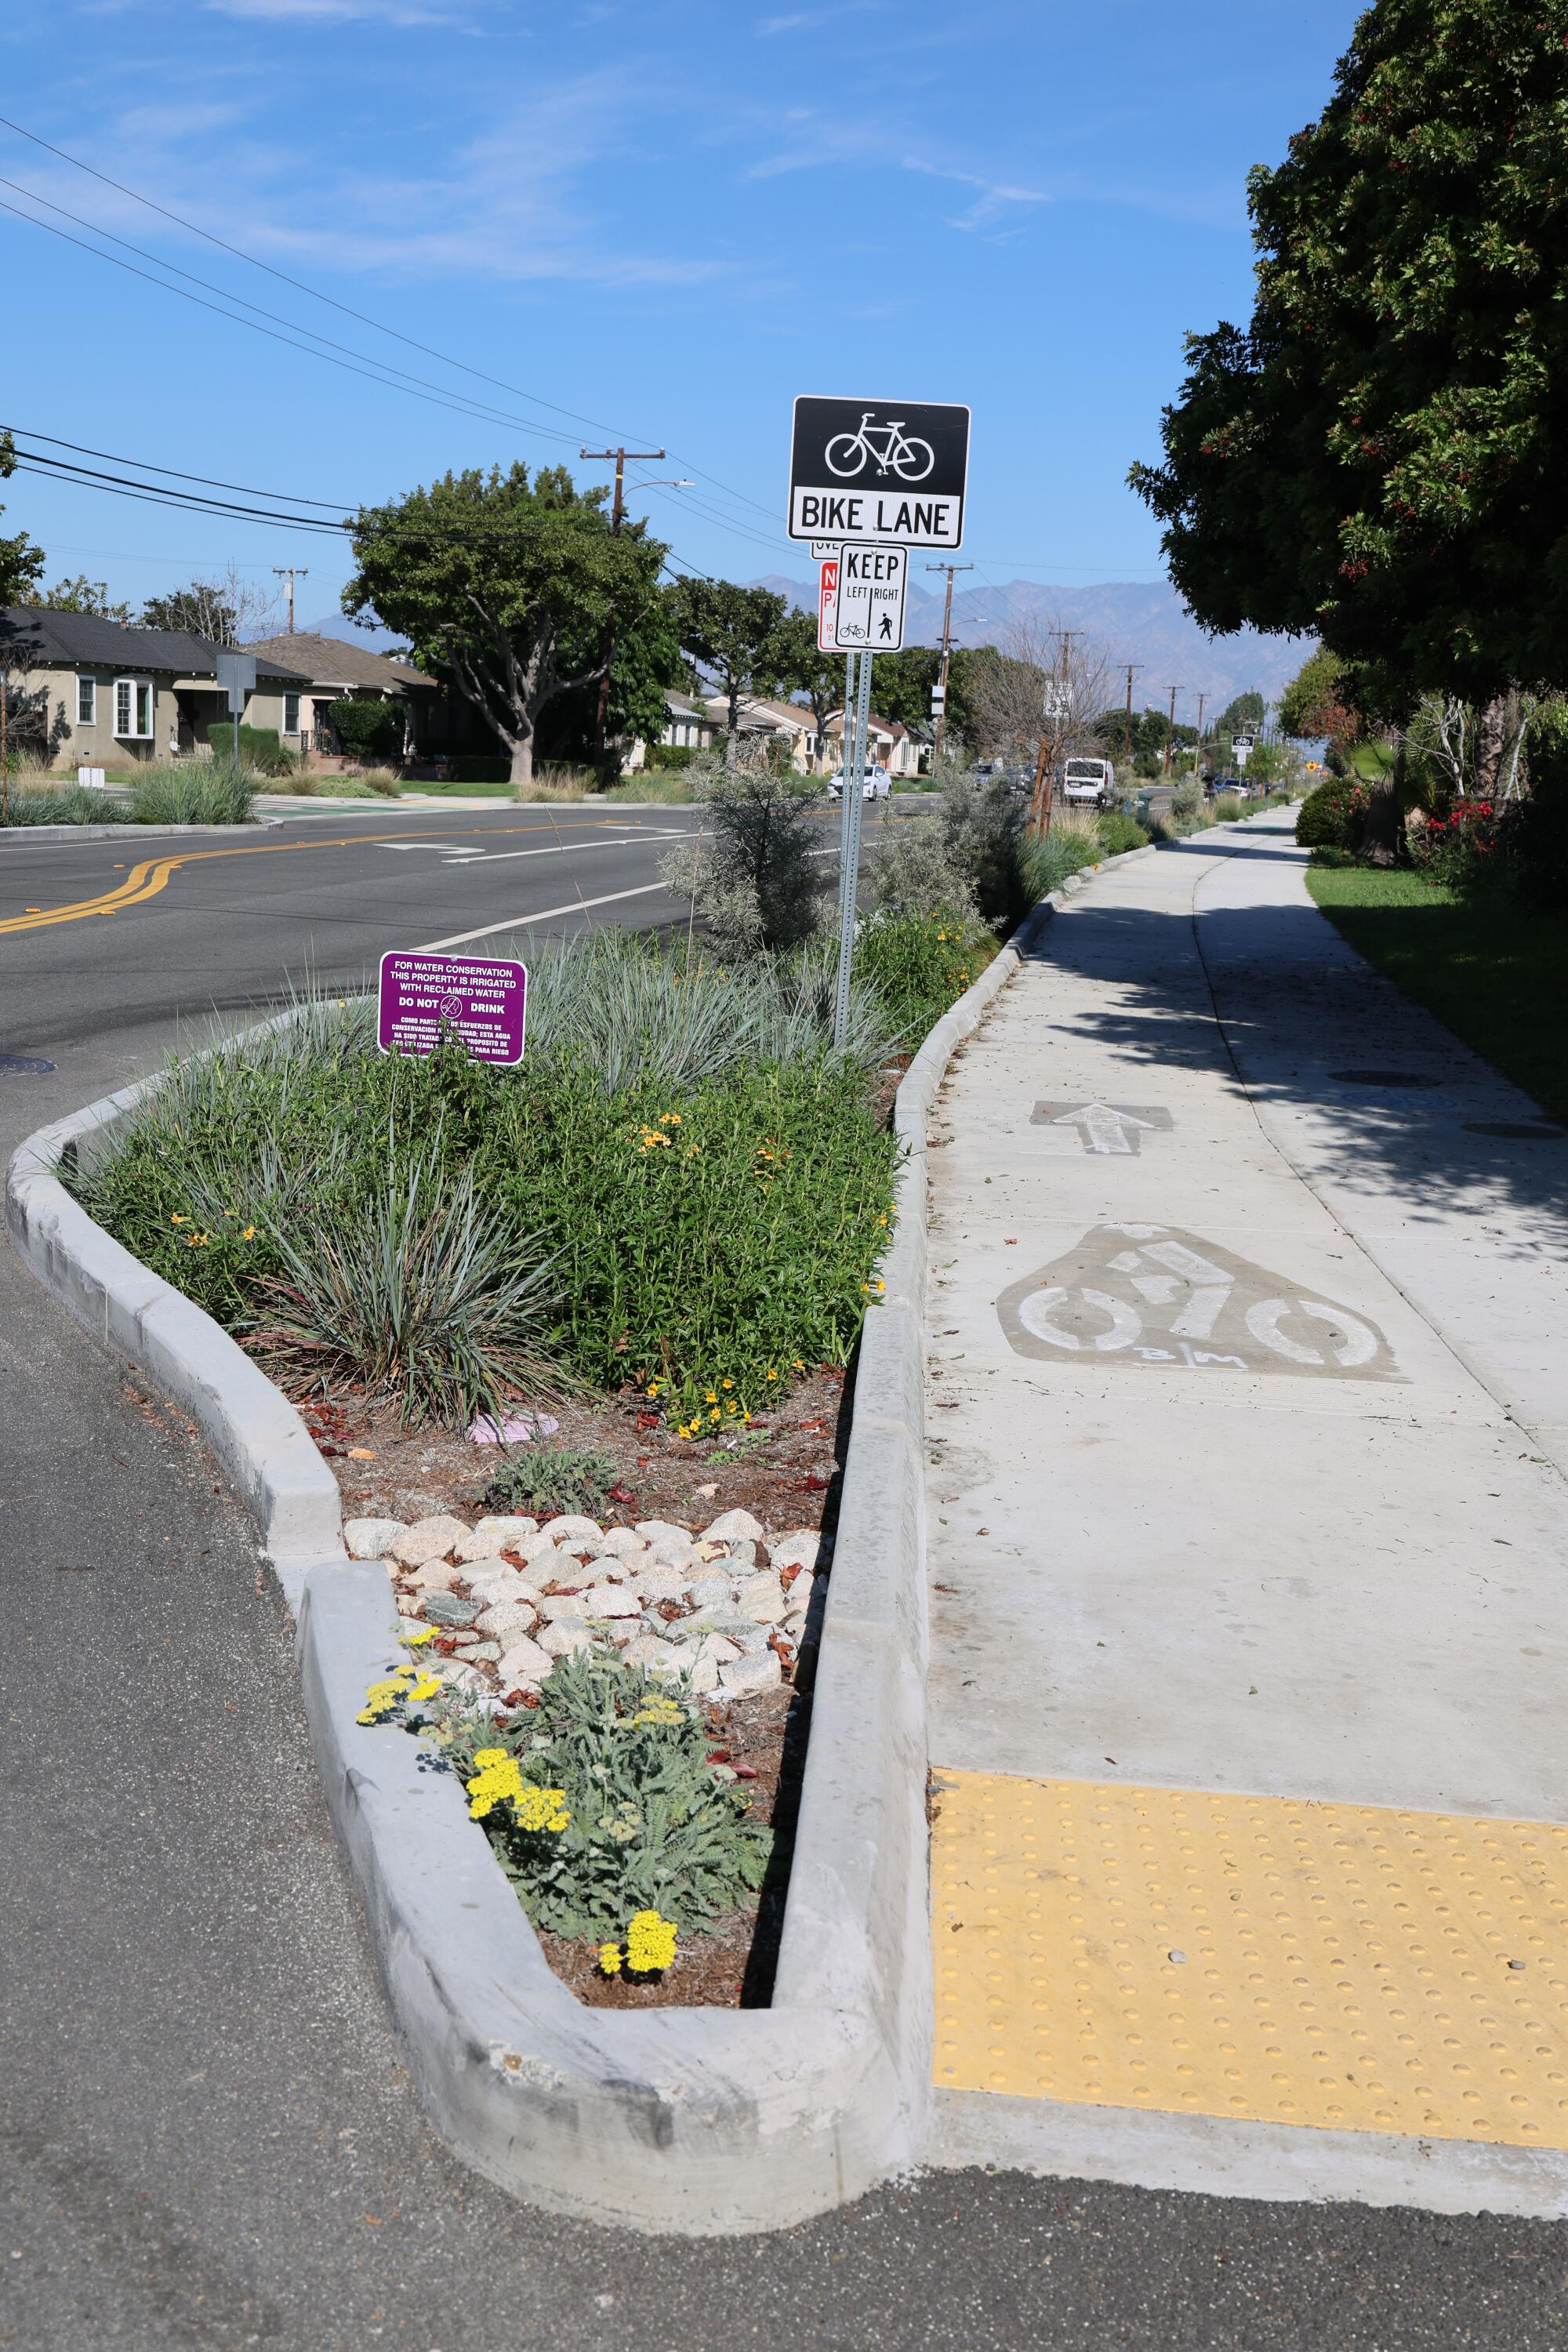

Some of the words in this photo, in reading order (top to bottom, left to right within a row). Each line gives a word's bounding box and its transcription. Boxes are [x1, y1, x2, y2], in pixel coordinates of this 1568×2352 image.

[801, 496, 863, 530] BIKE
[877, 500, 950, 535] LANE
[847, 553, 899, 581] KEEP
[847, 586, 868, 599] LEFT
[874, 588, 899, 601] RIGHT
[394, 961, 412, 970] FOR
[414, 962, 444, 972] WATER
[445, 965, 513, 978] CONSERVATION
[390, 971, 409, 980] THIS
[412, 973, 458, 984] PROPERTY
[470, 977, 517, 989] IRRIGATED
[400, 982, 422, 992] WITH
[423, 985, 474, 996] RECLAIMED
[475, 989, 506, 999] WATER
[399, 996, 414, 1006] DO
[416, 998, 439, 1008] NOT
[470, 1003, 505, 1014] DRINK
[391, 1024, 436, 1033] CONSERVACION
[460, 1022, 493, 1031] ESFUERZOS
[466, 1038, 499, 1047] PROPOSITO
